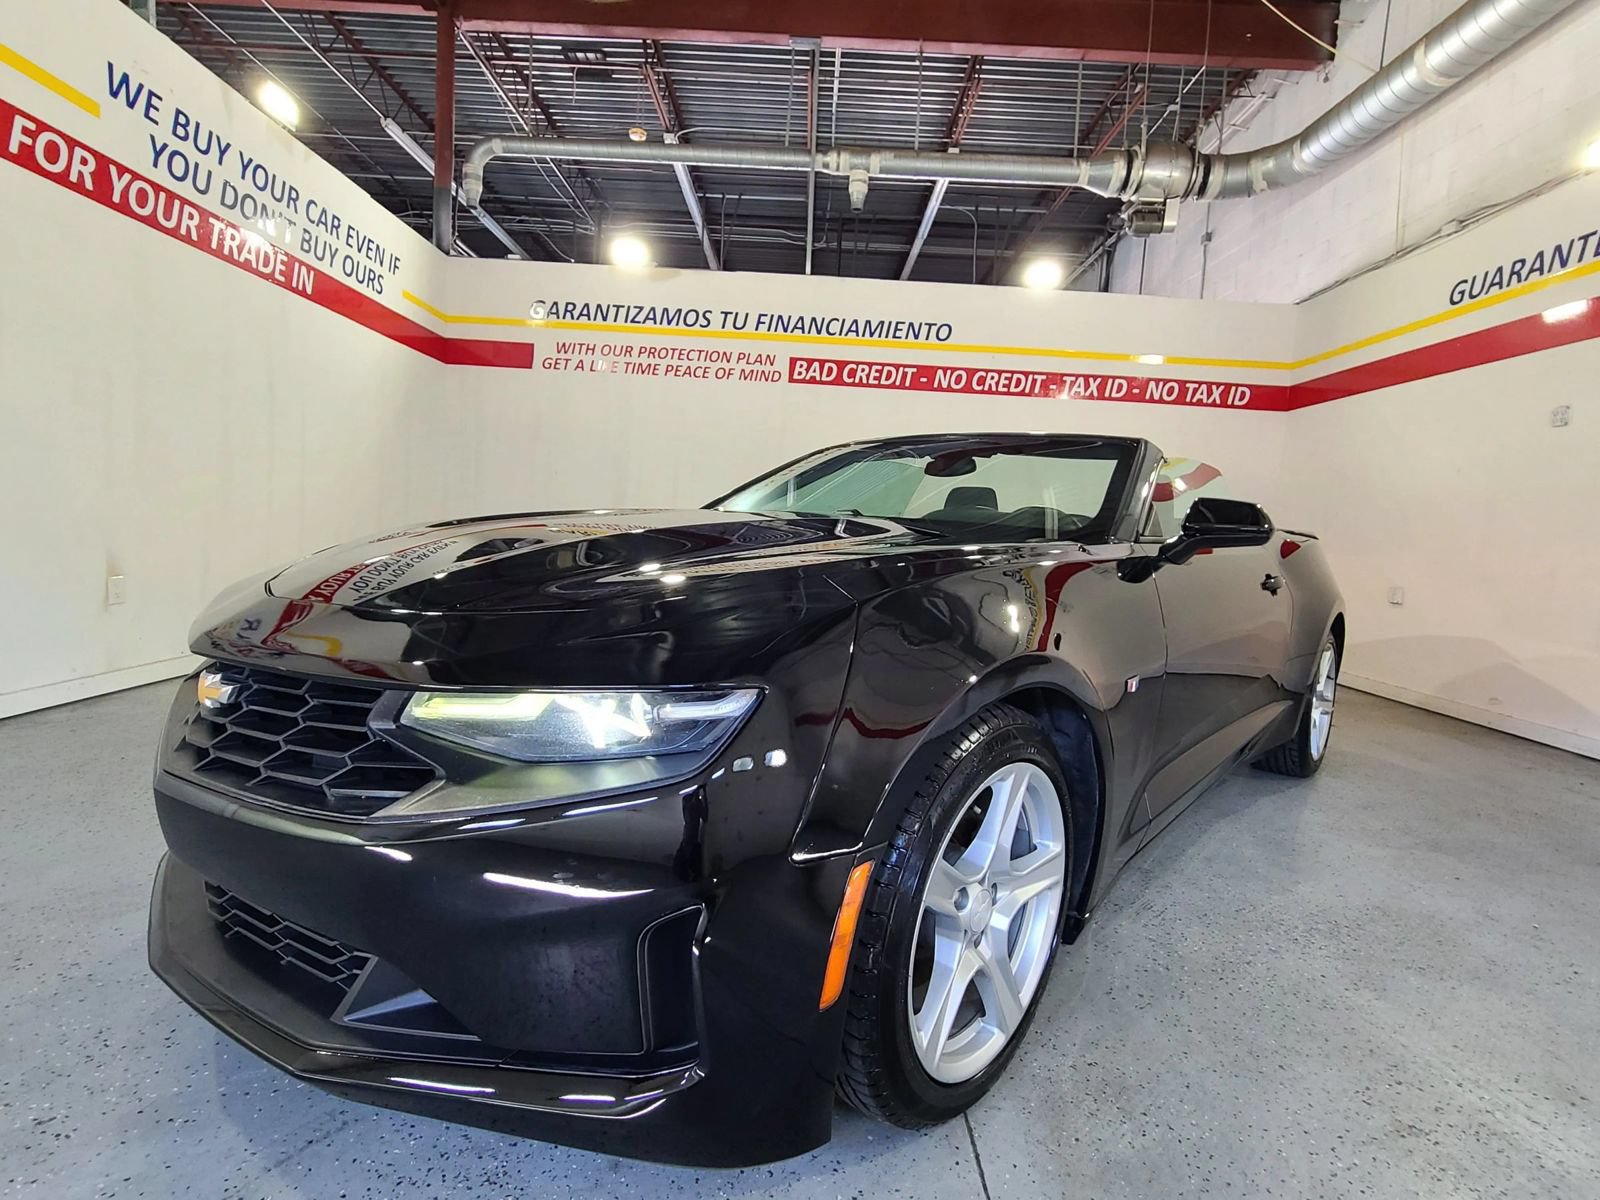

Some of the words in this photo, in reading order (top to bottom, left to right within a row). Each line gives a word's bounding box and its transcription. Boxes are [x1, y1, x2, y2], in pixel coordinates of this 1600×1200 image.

[107, 61, 163, 126] WE
[172, 107, 231, 166] BUY
[239, 150, 300, 214] YOUR
[305, 199, 341, 241] CAR
[345, 225, 386, 267] EVEN
[388, 253, 401, 275] IF
[8, 114, 97, 191] FOR
[108, 164, 200, 241] YOUR
[207, 216, 288, 282] TRADE
[291, 261, 315, 295] IN
[150, 134, 212, 195] YOU
[220, 179, 296, 243] DON'T
[300, 228, 339, 268] BUY
[342, 254, 384, 295] OURS
[529, 299, 712, 328] GARANTIZAMOS
[720, 310, 749, 331] TU
[754, 312, 953, 342] FINANCIAMIENTO
[542, 357, 572, 371] GET
[574, 358, 585, 372] A
[590, 359, 619, 373] LIE
[623, 361, 660, 376] TIME
[664, 364, 711, 379] PEACE
[715, 367, 735, 380] OF
[738, 368, 782, 383] MIND
[555, 341, 597, 356] WITH
[600, 343, 634, 358] OUR
[637, 345, 733, 364] PROTECTION
[736, 351, 776, 367] PLAN
[793, 360, 838, 382] BAD
[842, 363, 917, 388] CREDIT
[933, 369, 967, 390] NO
[971, 371, 1047, 394] CREDIT
[1061, 375, 1102, 398] TAX
[1104, 378, 1128, 398] ID
[1145, 380, 1179, 401] NO
[1185, 383, 1225, 405] TAX
[1227, 386, 1251, 406] ID
